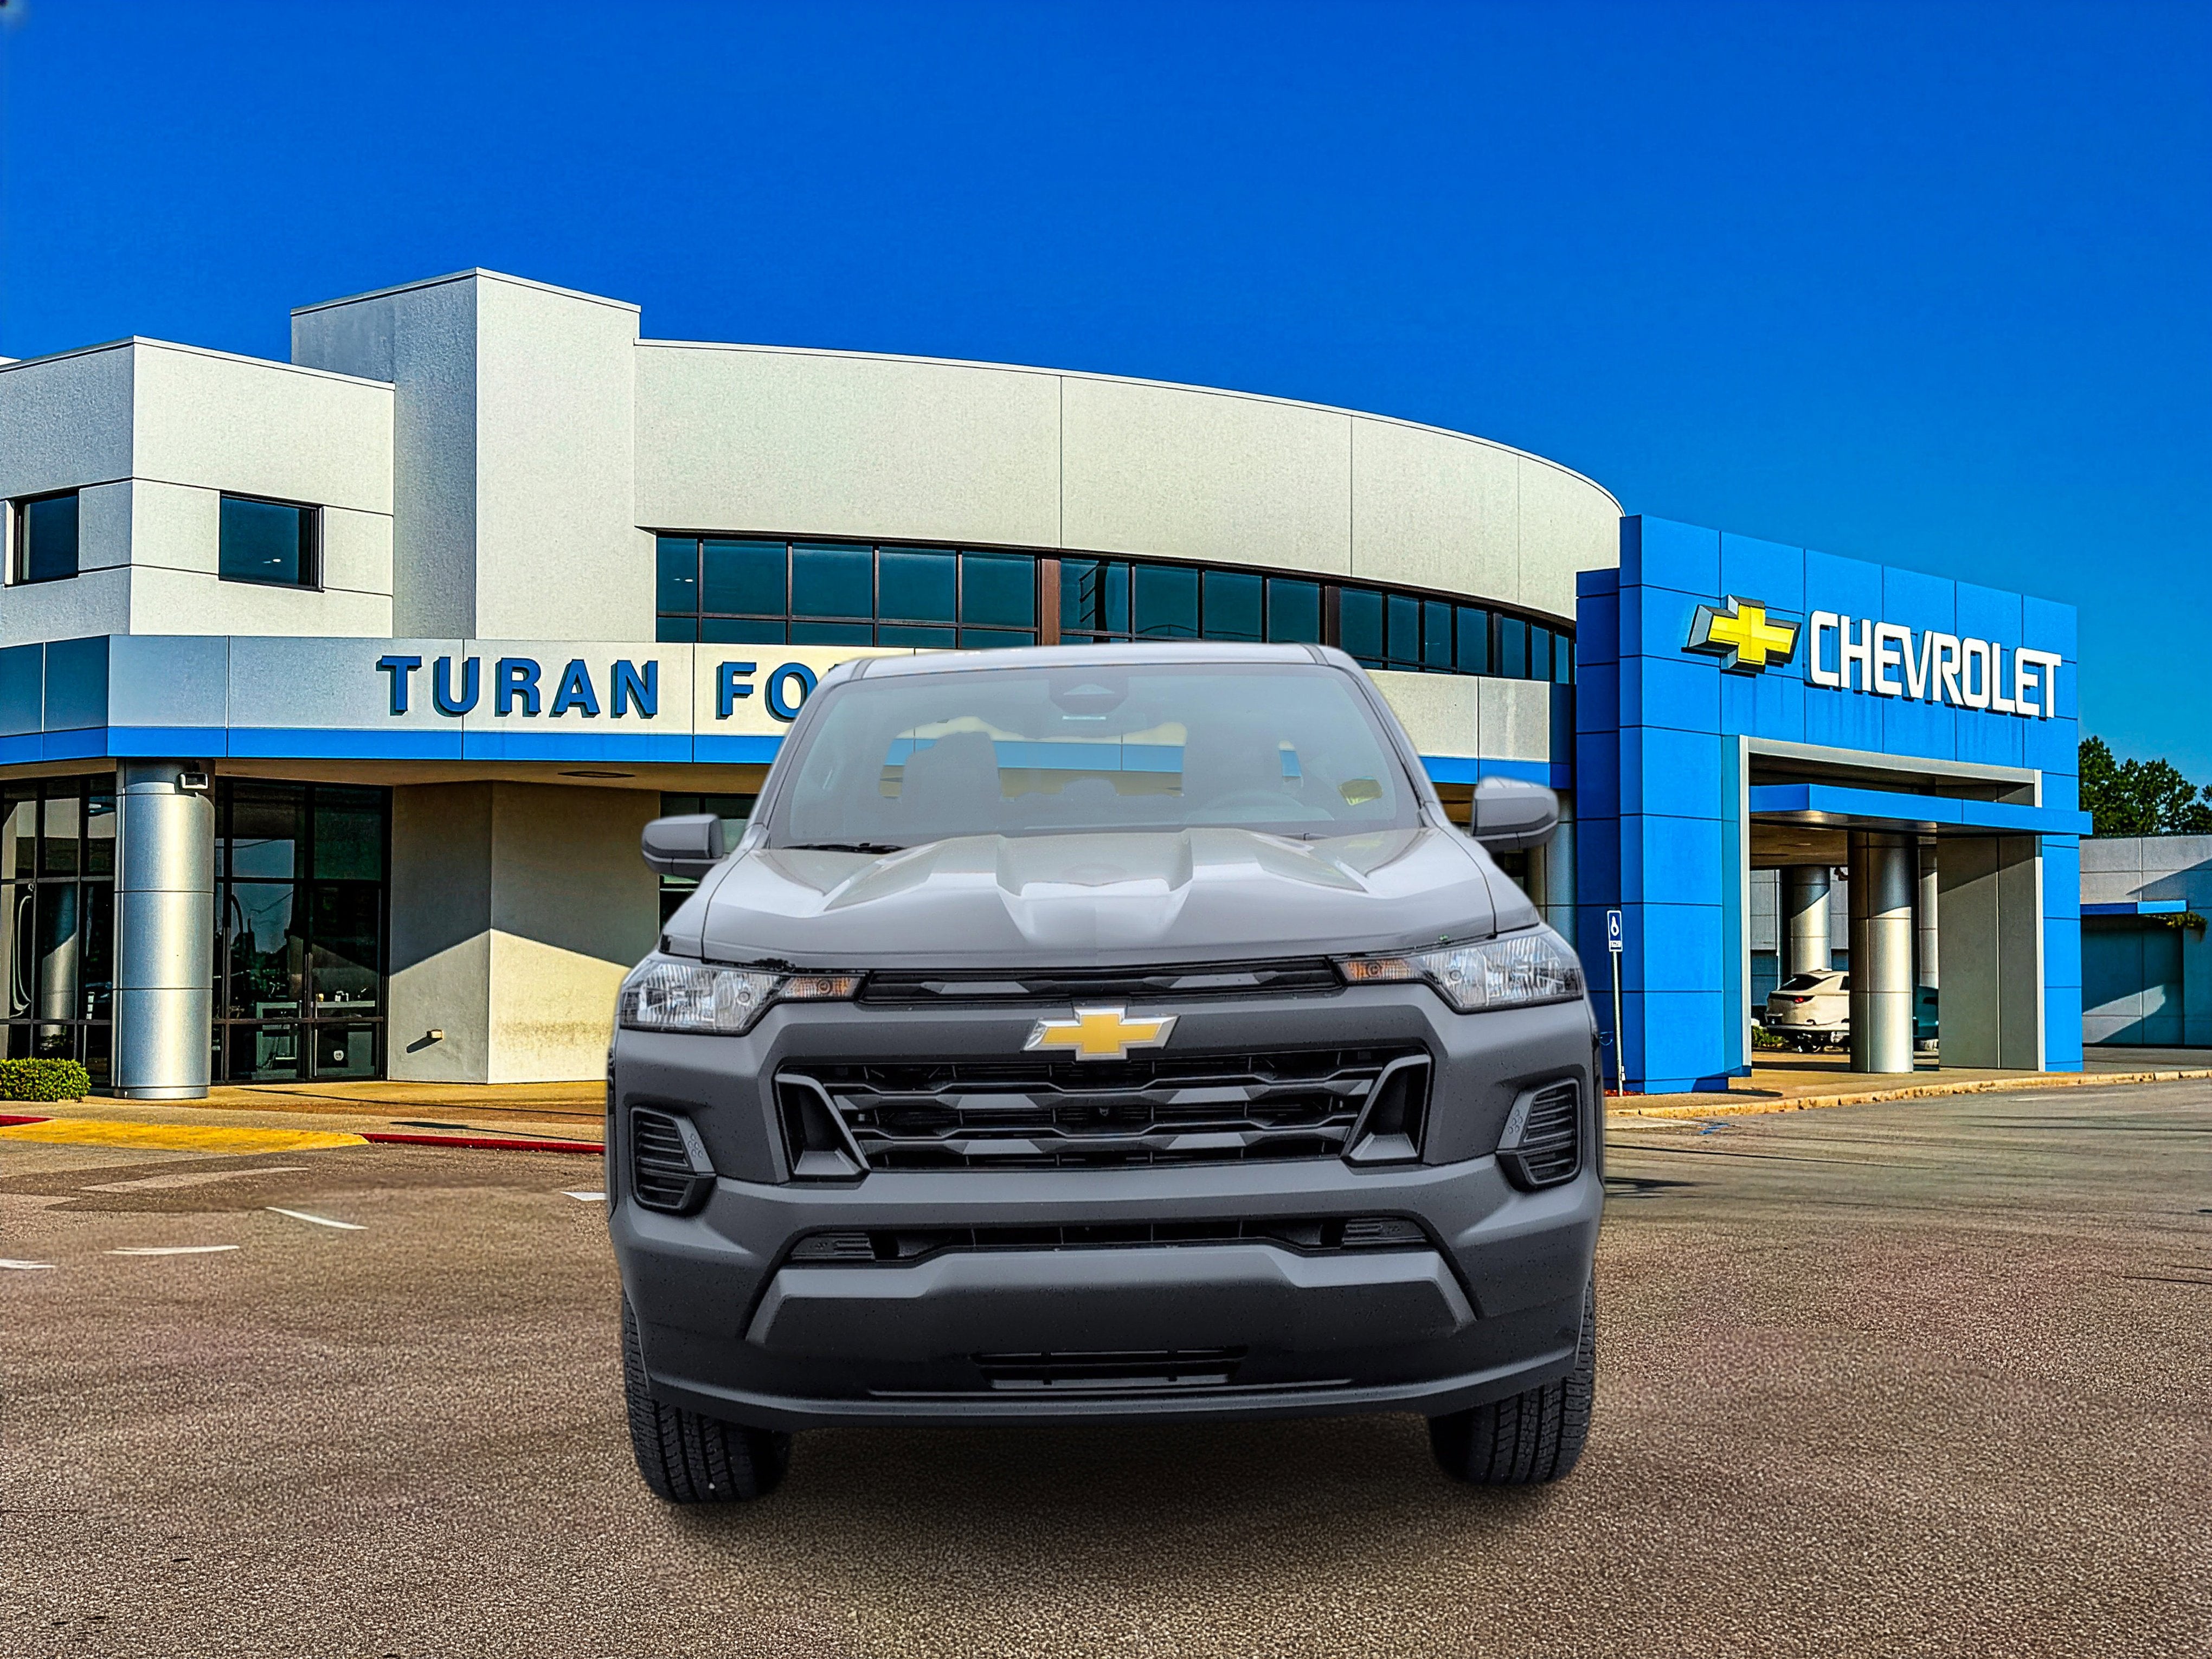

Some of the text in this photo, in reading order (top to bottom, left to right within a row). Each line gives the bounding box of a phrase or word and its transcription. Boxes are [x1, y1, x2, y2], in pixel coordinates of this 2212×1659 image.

[376, 655, 841, 723] TURAN FO
[1806, 610, 2062, 719] CHEVROLET
